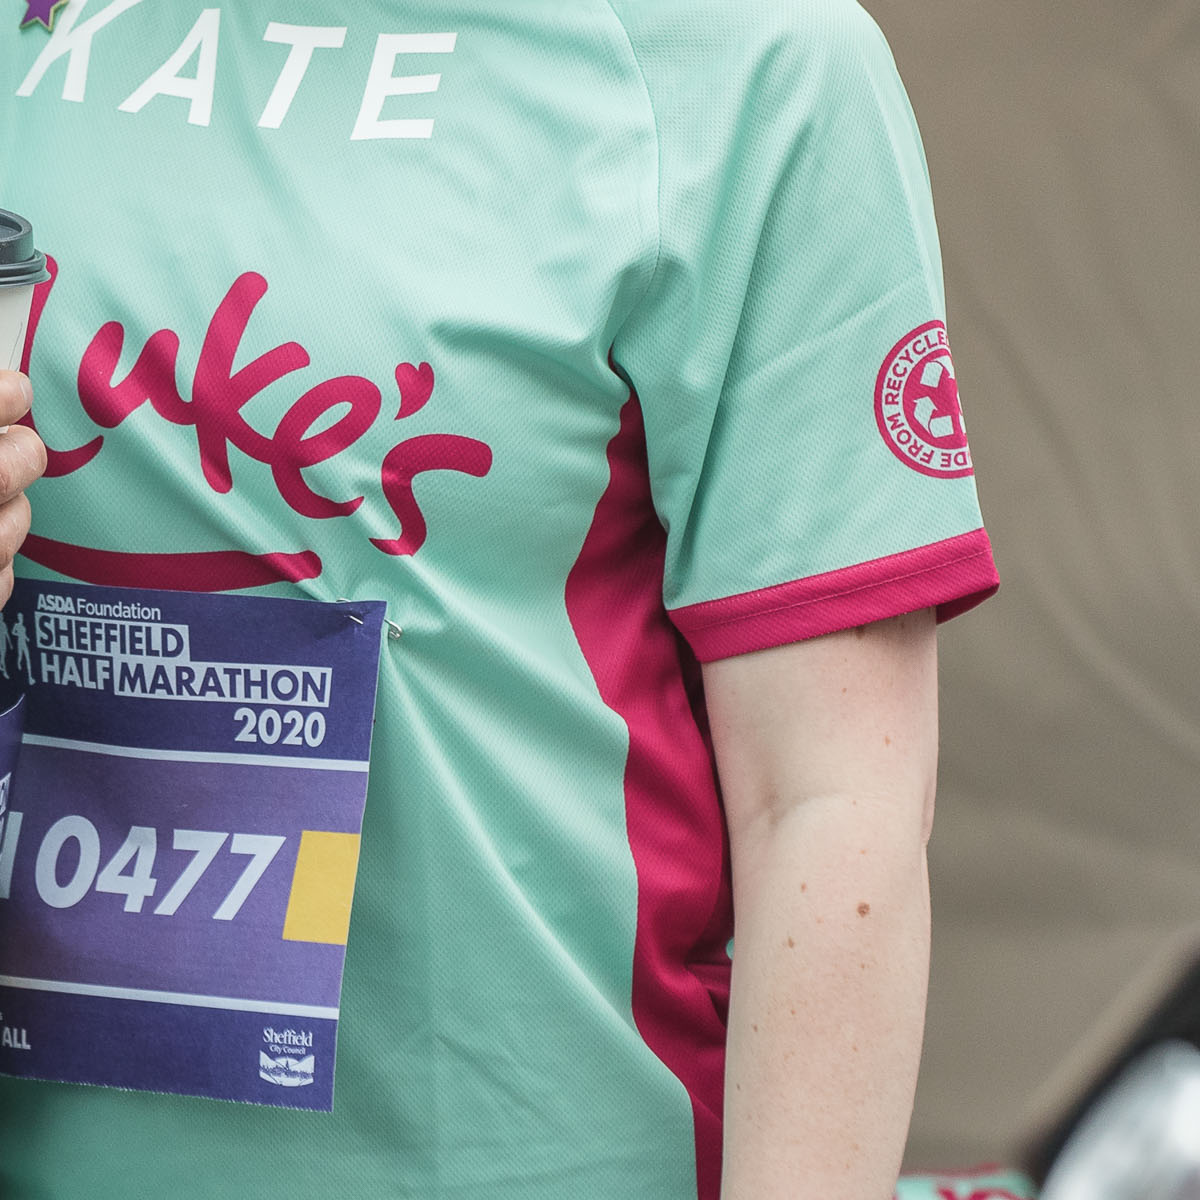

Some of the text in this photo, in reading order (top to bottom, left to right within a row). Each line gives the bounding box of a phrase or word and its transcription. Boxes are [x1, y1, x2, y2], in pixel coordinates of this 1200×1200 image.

[884, 330, 950, 406] RECYCLE
[886, 412, 935, 465] FROM
[36, 593, 162, 621] ASDA Foundation
[38, 614, 185, 659] SHEFFIELD
[40, 651, 328, 704] HALF MARATHON
[233, 706, 327, 748] 2020
[2, 1025, 32, 1051] ALL
[263, 1026, 313, 1048] Sheffield
